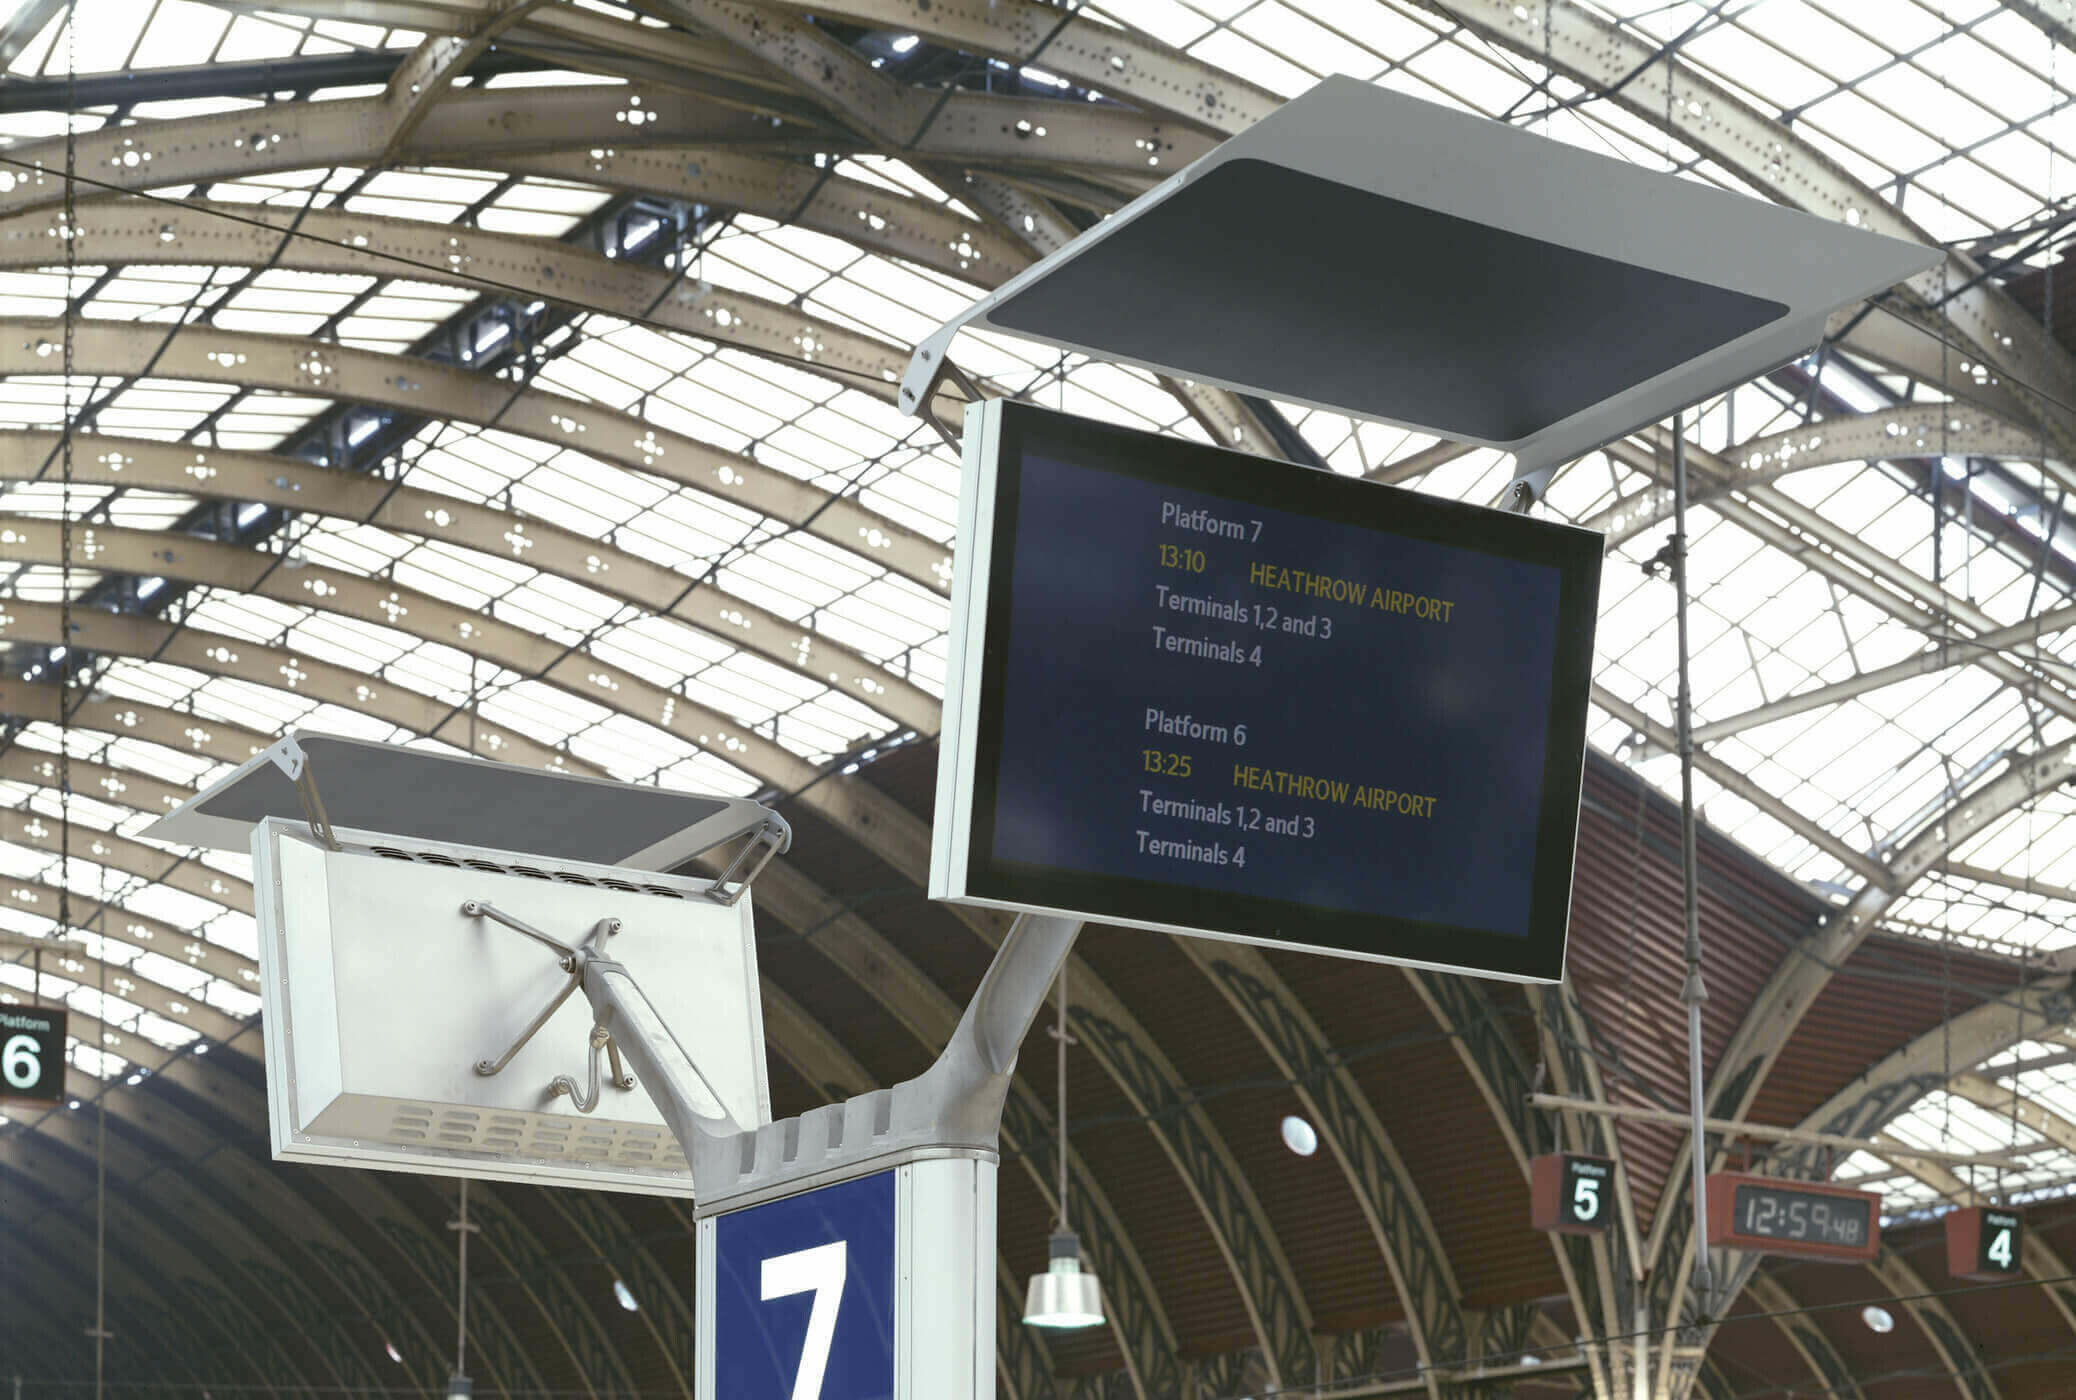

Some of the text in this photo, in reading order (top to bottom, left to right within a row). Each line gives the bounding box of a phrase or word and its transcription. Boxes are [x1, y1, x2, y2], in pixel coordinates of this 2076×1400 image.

[1162, 502, 1263, 542] Platform 7
[1160, 545, 1453, 622] 13:10 HEATHROW AIRPORT
[1156, 585, 1331, 639] Terminals 1,2 and 3
[1153, 626, 1262, 667] Terminals 4
[1145, 708, 1247, 746] Platform 6
[1144, 750, 1436, 817] 13:25 HEATHROW AIRPORT
[1139, 789, 1314, 838] Terminals 1,2 and 3
[1136, 830, 1245, 868] Terminals 4
[2, 1034, 41, 1089] 6
[1573, 1178, 1599, 1221] 5
[1988, 1229, 2012, 1268] 4
[761, 1240, 847, 1400] 7
